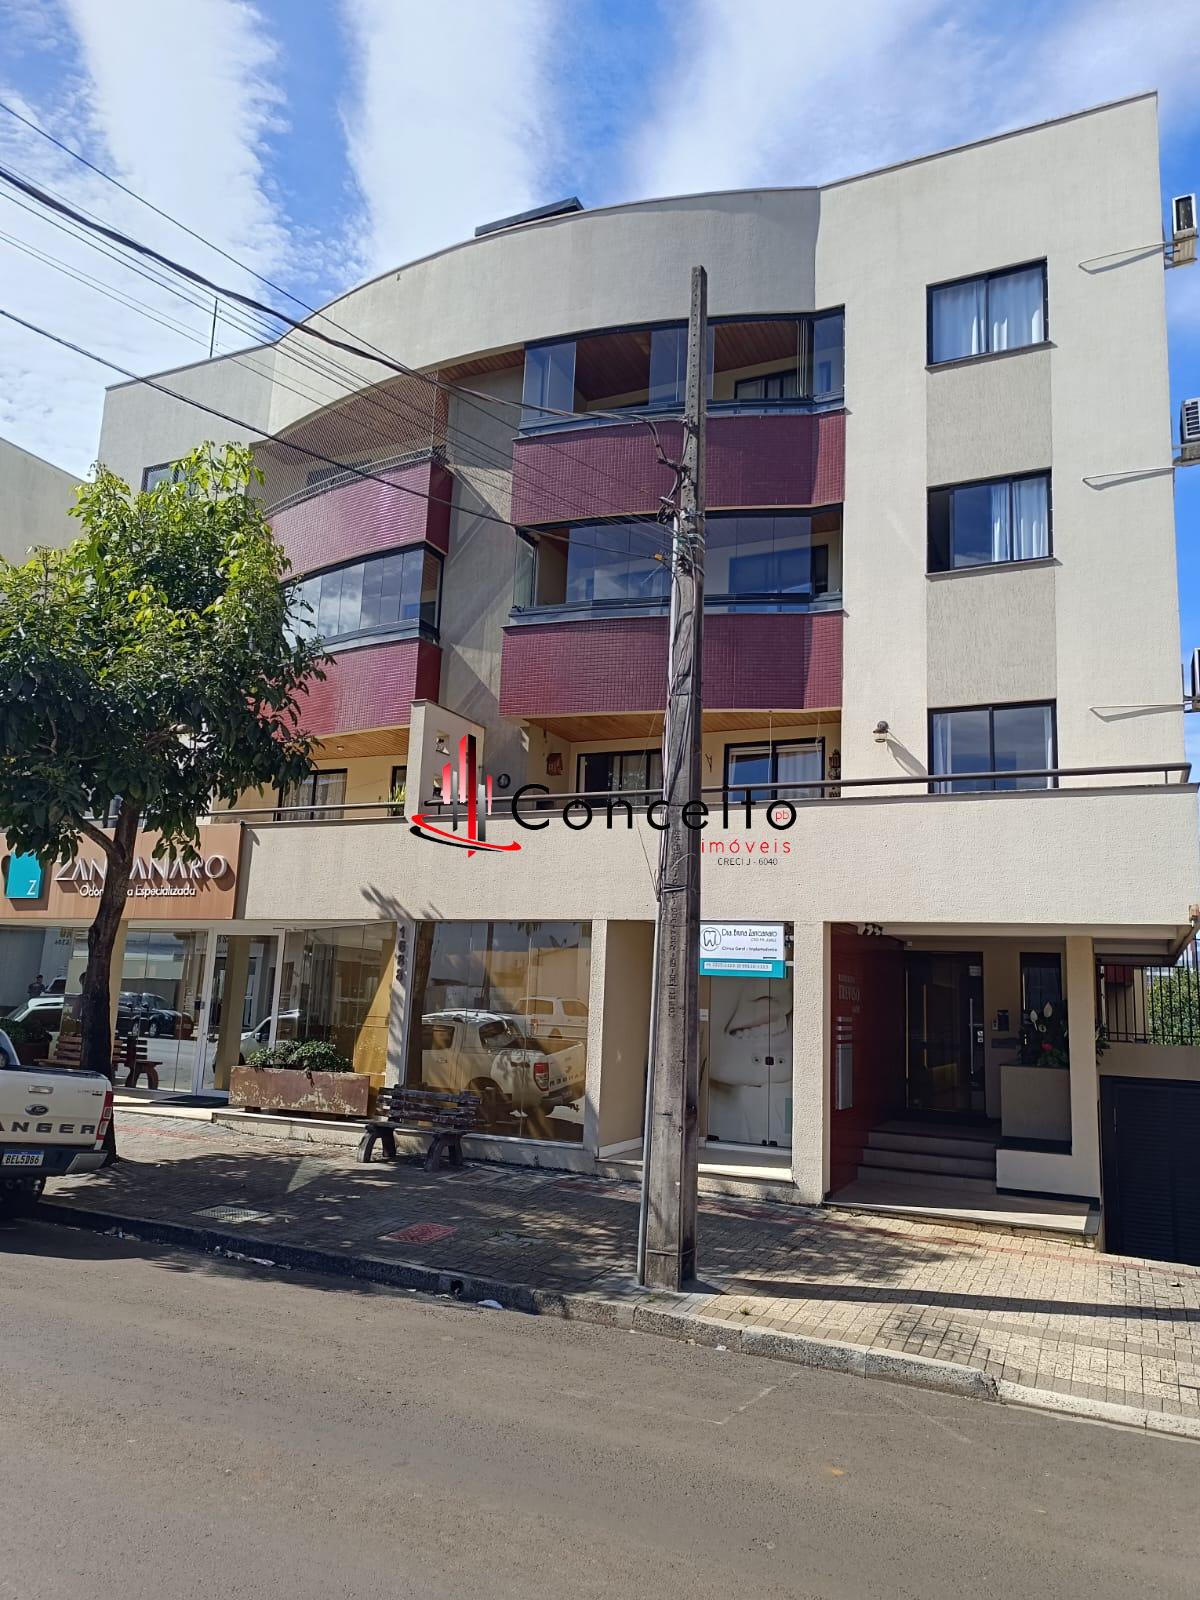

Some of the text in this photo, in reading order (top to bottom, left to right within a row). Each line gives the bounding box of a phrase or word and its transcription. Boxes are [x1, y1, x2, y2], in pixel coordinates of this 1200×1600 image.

[54, 852, 228, 881] ZANANARO
[26, 879, 38, 896] Z
[135, 884, 196, 898] Especializada
[0, 1121, 96, 1134] NGER
